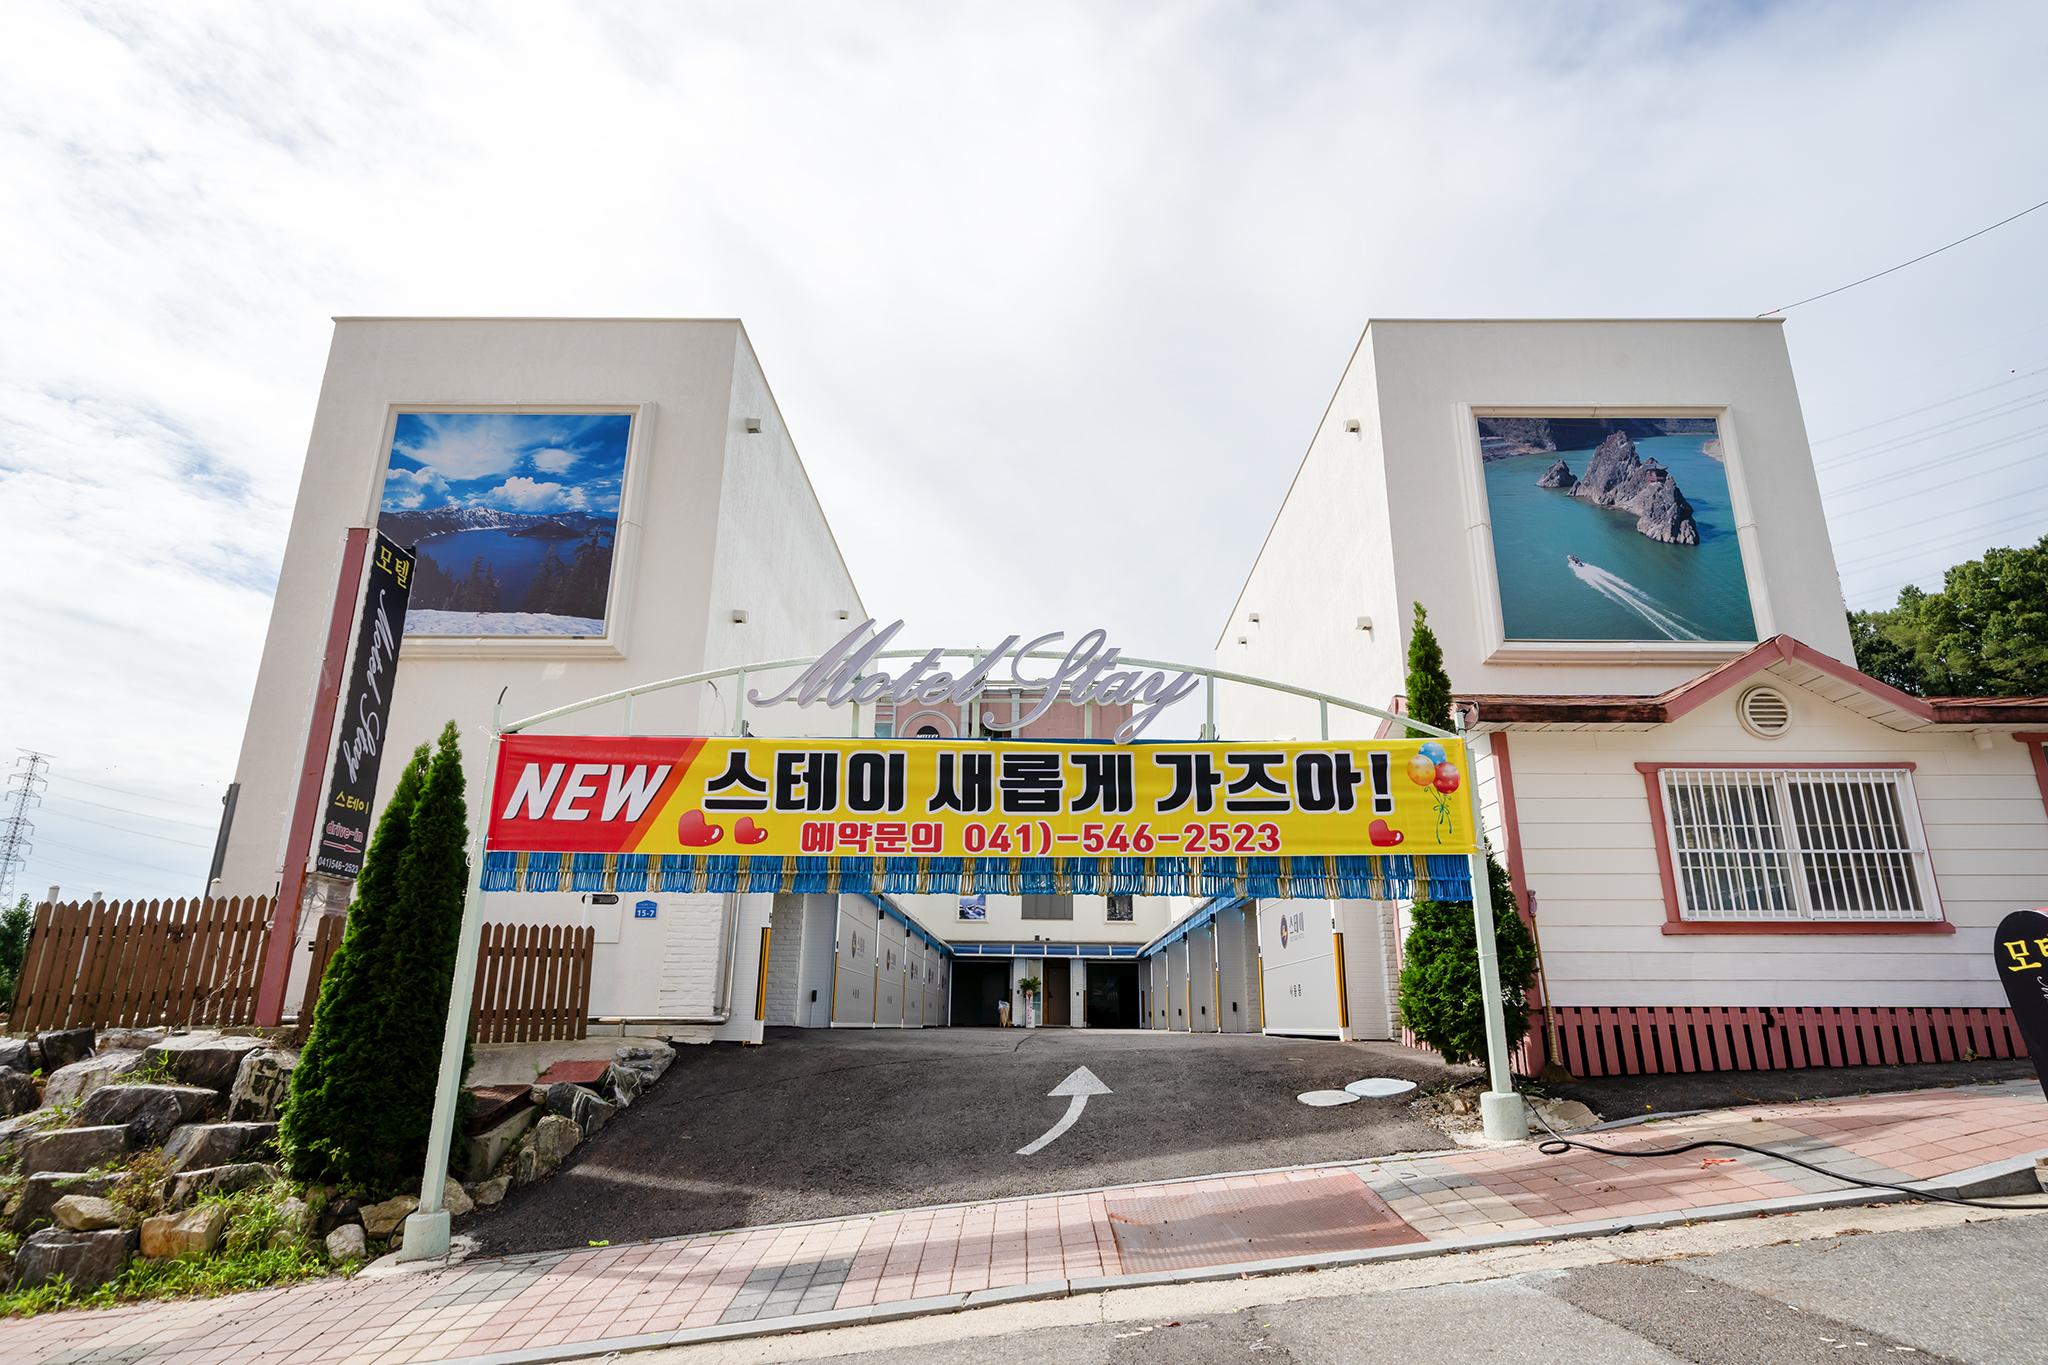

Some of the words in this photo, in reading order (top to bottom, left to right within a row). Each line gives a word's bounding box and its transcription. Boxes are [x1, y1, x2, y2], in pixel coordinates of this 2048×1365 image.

[375, 545, 410, 589] 모텔
[367, 589, 396, 705] Motel
[747, 618, 1021, 709] Motel
[982, 628, 1200, 746] Stay
[343, 692, 380, 785] Stay
[334, 790, 370, 816] 스테이
[502, 762, 673, 823] NEW
[701, 749, 908, 815] 스테이
[927, 749, 1135, 816] 새롭게
[1153, 750, 1394, 816] 가즈아!
[326, 820, 364, 843] drive-in
[800, 821, 944, 855] 예약문의
[964, 821, 1282, 858] 041)-546-2523
[318, 856, 359, 875] 041)546-2523
[636, 909, 655, 917] 15-7
